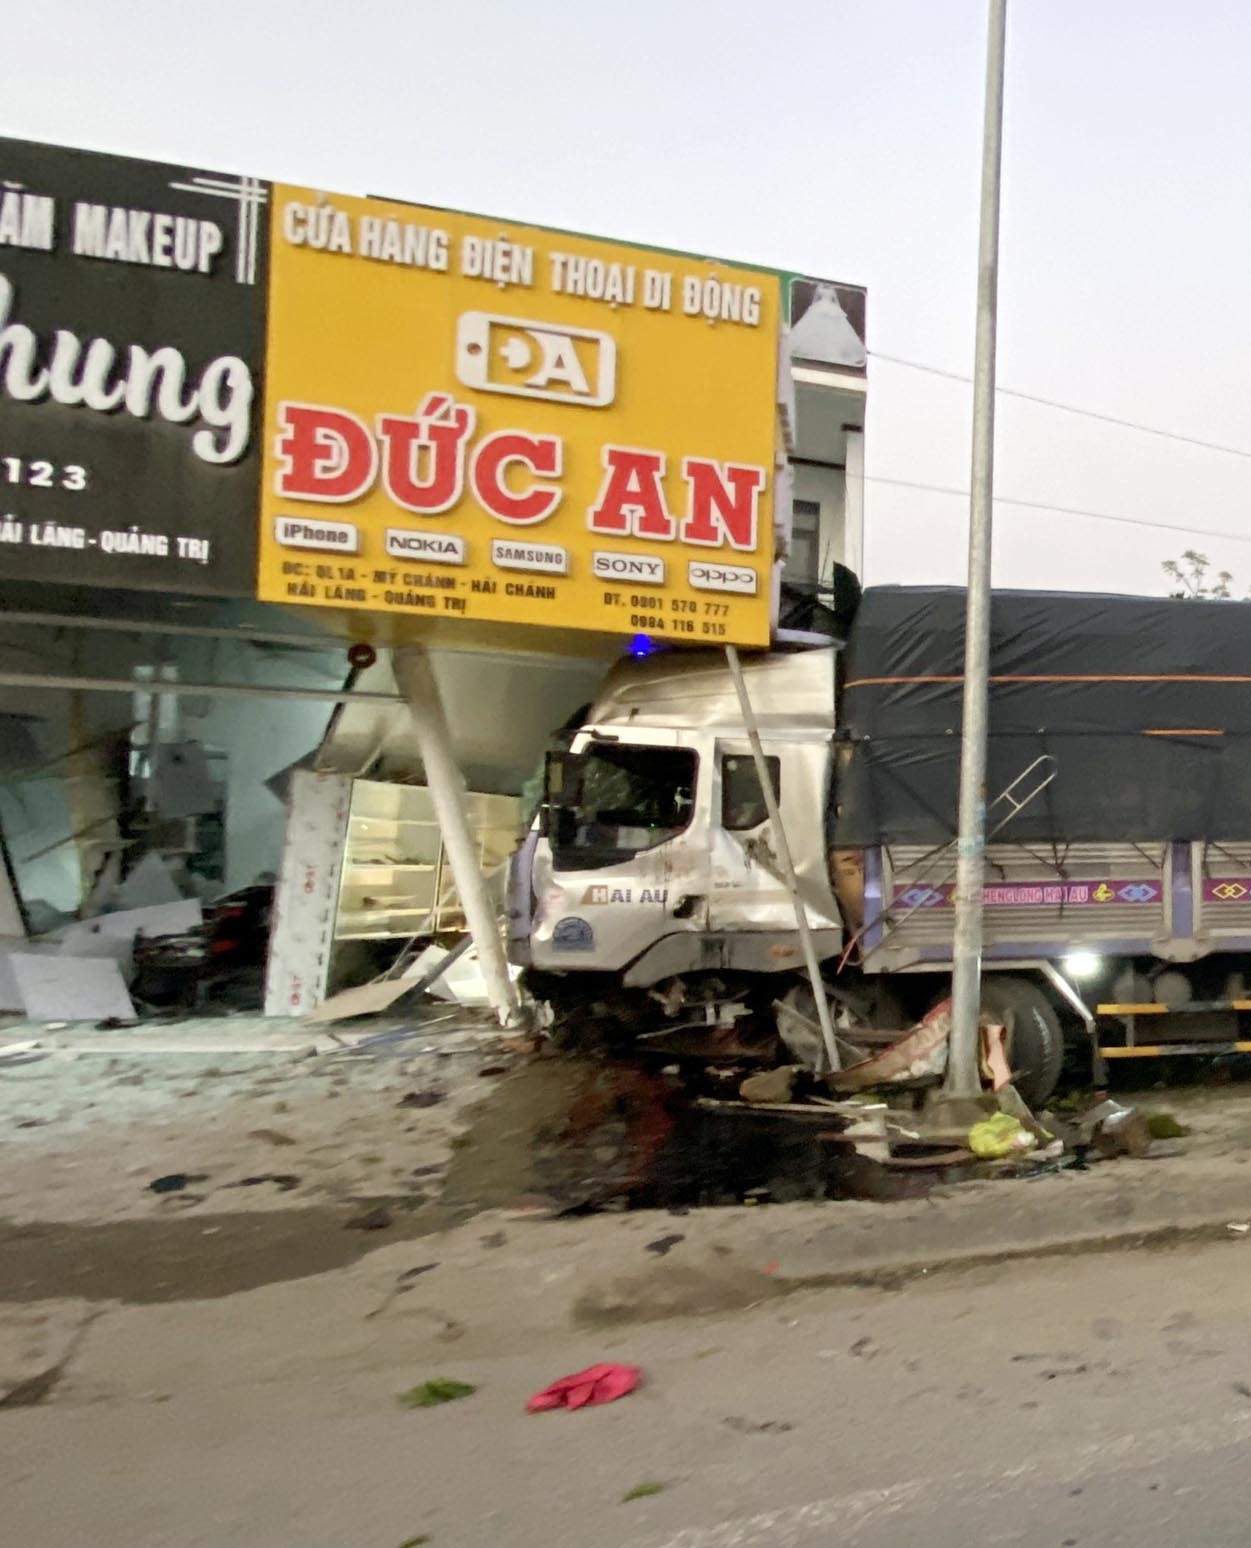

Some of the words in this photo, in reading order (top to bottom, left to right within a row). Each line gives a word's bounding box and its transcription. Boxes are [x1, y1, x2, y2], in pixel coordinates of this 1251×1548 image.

[73, 202, 223, 273] MAKEUP
[462, 232, 533, 288] ĐIỆN
[549, 251, 636, 308] THOẠI
[643, 269, 672, 310] DI
[683, 272, 761, 325] ĐỘNG
[274, 392, 562, 525] ĐỨC
[587, 444, 765, 552] AN
[284, 523, 348, 544] iPhone
[101, 526, 168, 555] QUẢNG
[177, 537, 209, 564] TRỊ
[390, 536, 458, 555] NOKIA
[495, 546, 563, 565] SAMSUNG
[596, 557, 661, 575] SONY
[704, 603, 729, 616] 777
